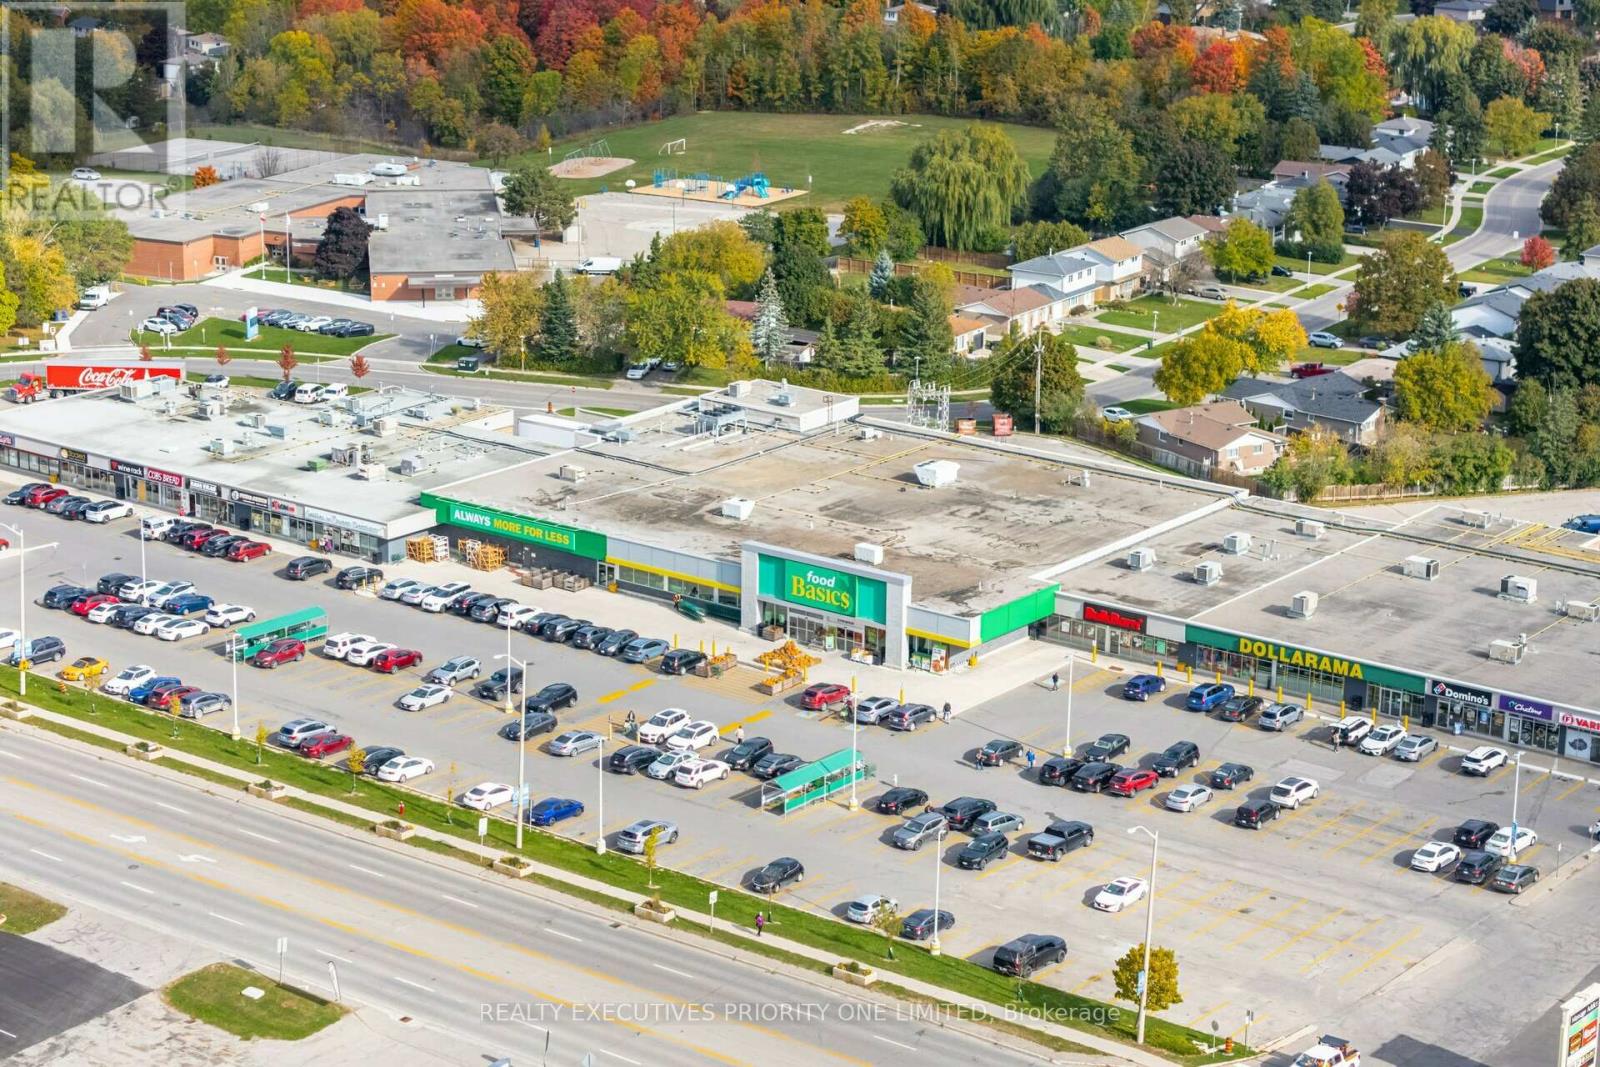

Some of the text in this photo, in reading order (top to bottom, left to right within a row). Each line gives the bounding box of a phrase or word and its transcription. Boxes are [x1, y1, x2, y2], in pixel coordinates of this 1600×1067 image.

[454, 509, 570, 545] ALWAYS MORE FOR LESS
[807, 570, 836, 588] food
[1239, 637, 1363, 680] DOLLARAMA
[1445, 688, 1489, 705] Domino's
